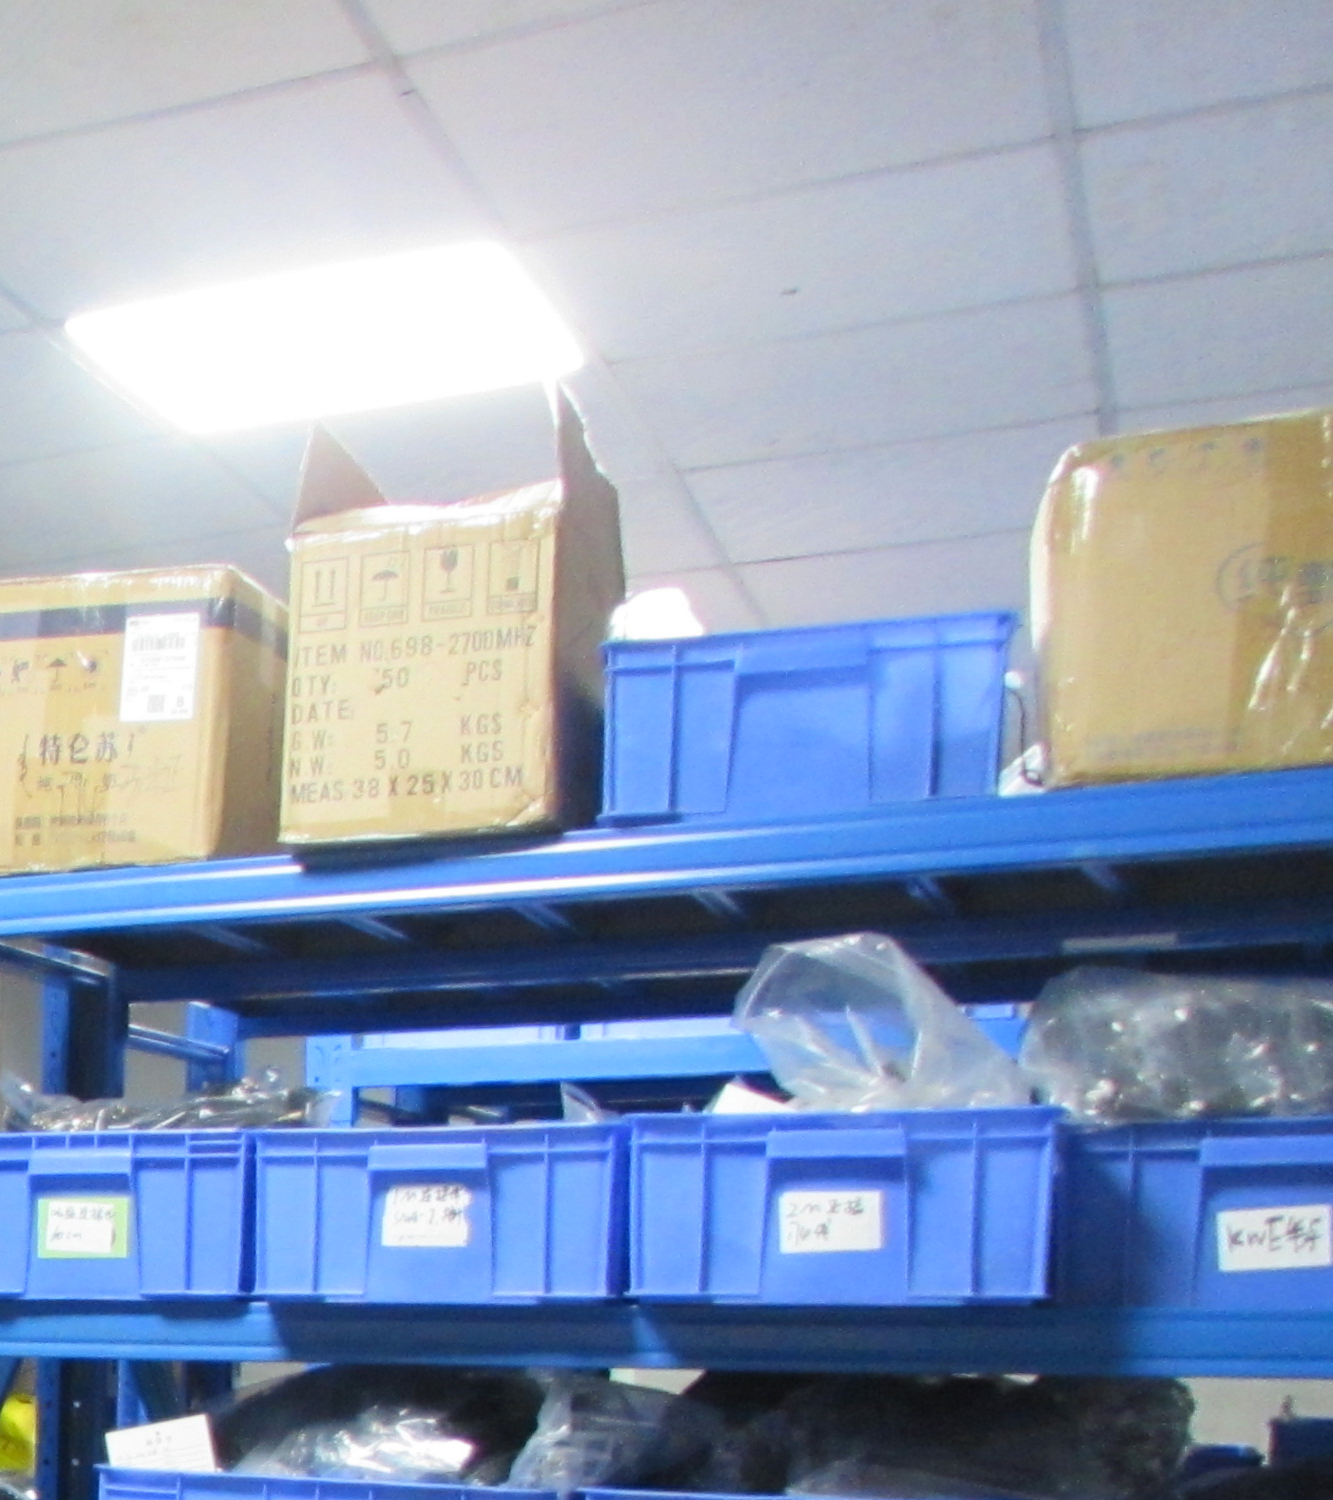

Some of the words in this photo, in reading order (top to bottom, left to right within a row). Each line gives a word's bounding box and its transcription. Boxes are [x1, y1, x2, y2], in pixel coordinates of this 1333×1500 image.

[294, 642, 347, 668] ITEM
[381, 666, 410, 688] 50
[464, 659, 502, 683] PCS
[460, 713, 502, 736] KGS
[39, 731, 118, 766] 特仑苏
[460, 740, 504, 764] KGS
[351, 777, 380, 799] 38
[406, 773, 435, 795] 25
[458, 769, 483, 791] 30
[488, 765, 524, 788] CM
